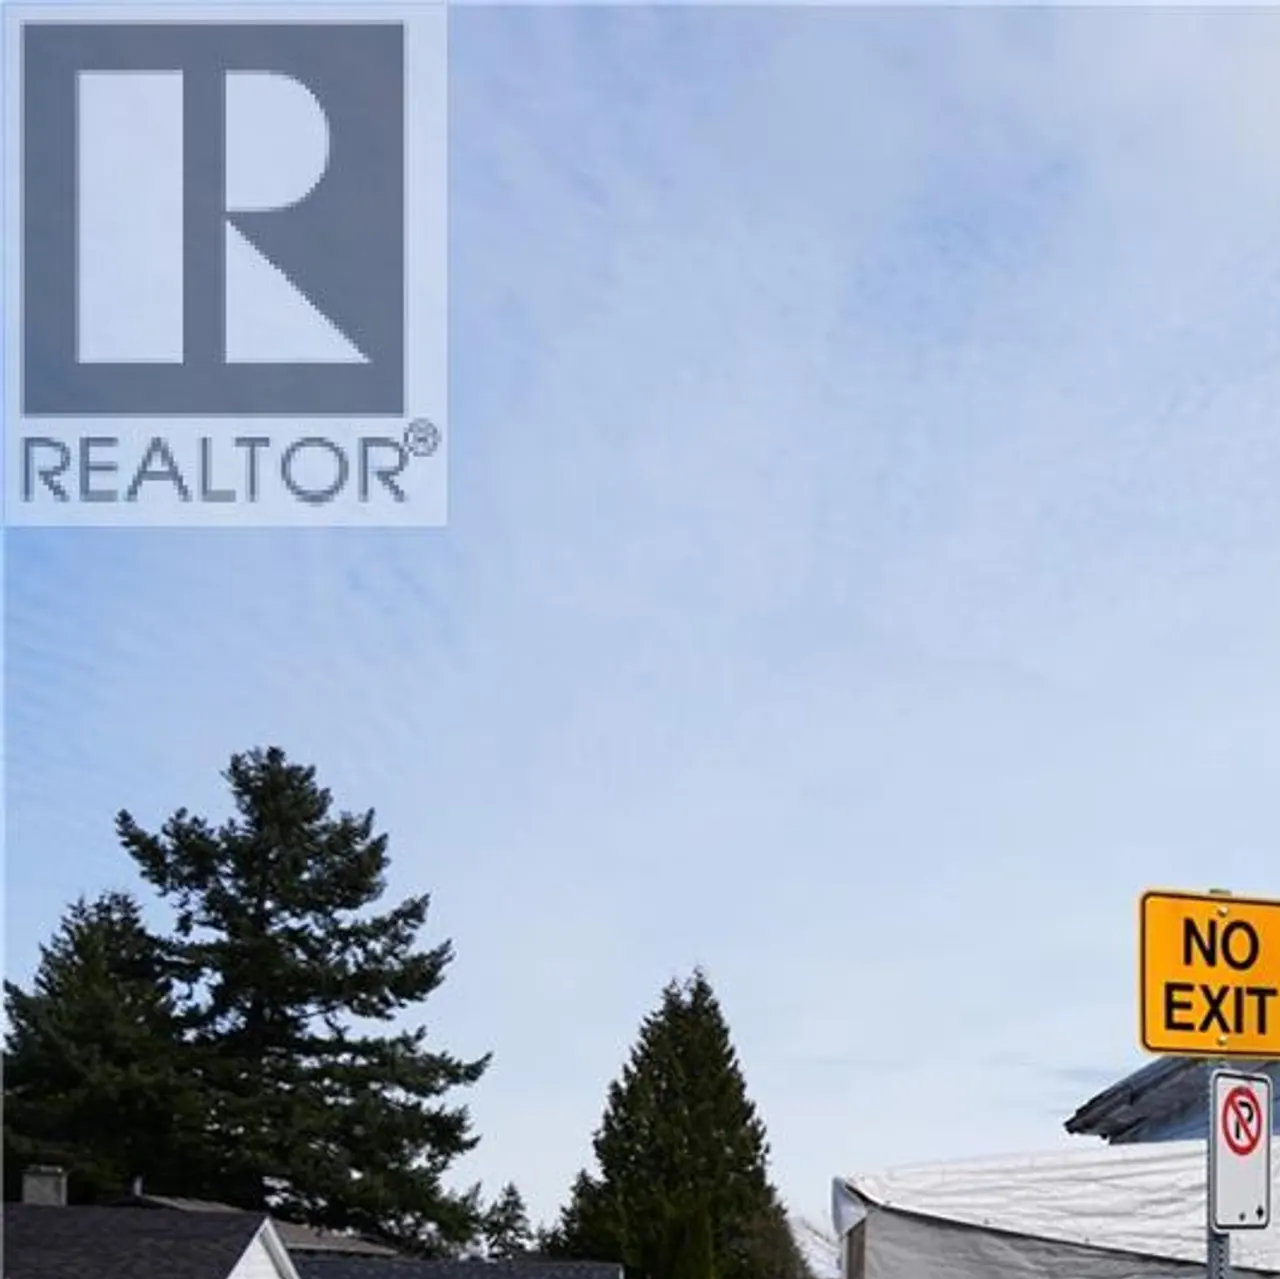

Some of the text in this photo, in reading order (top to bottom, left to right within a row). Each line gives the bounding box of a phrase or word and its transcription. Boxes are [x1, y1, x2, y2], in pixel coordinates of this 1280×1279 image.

[1183, 917, 1260, 971] NO
[1163, 981, 1279, 1035] EXIT
[1234, 1101, 1255, 1141] P
